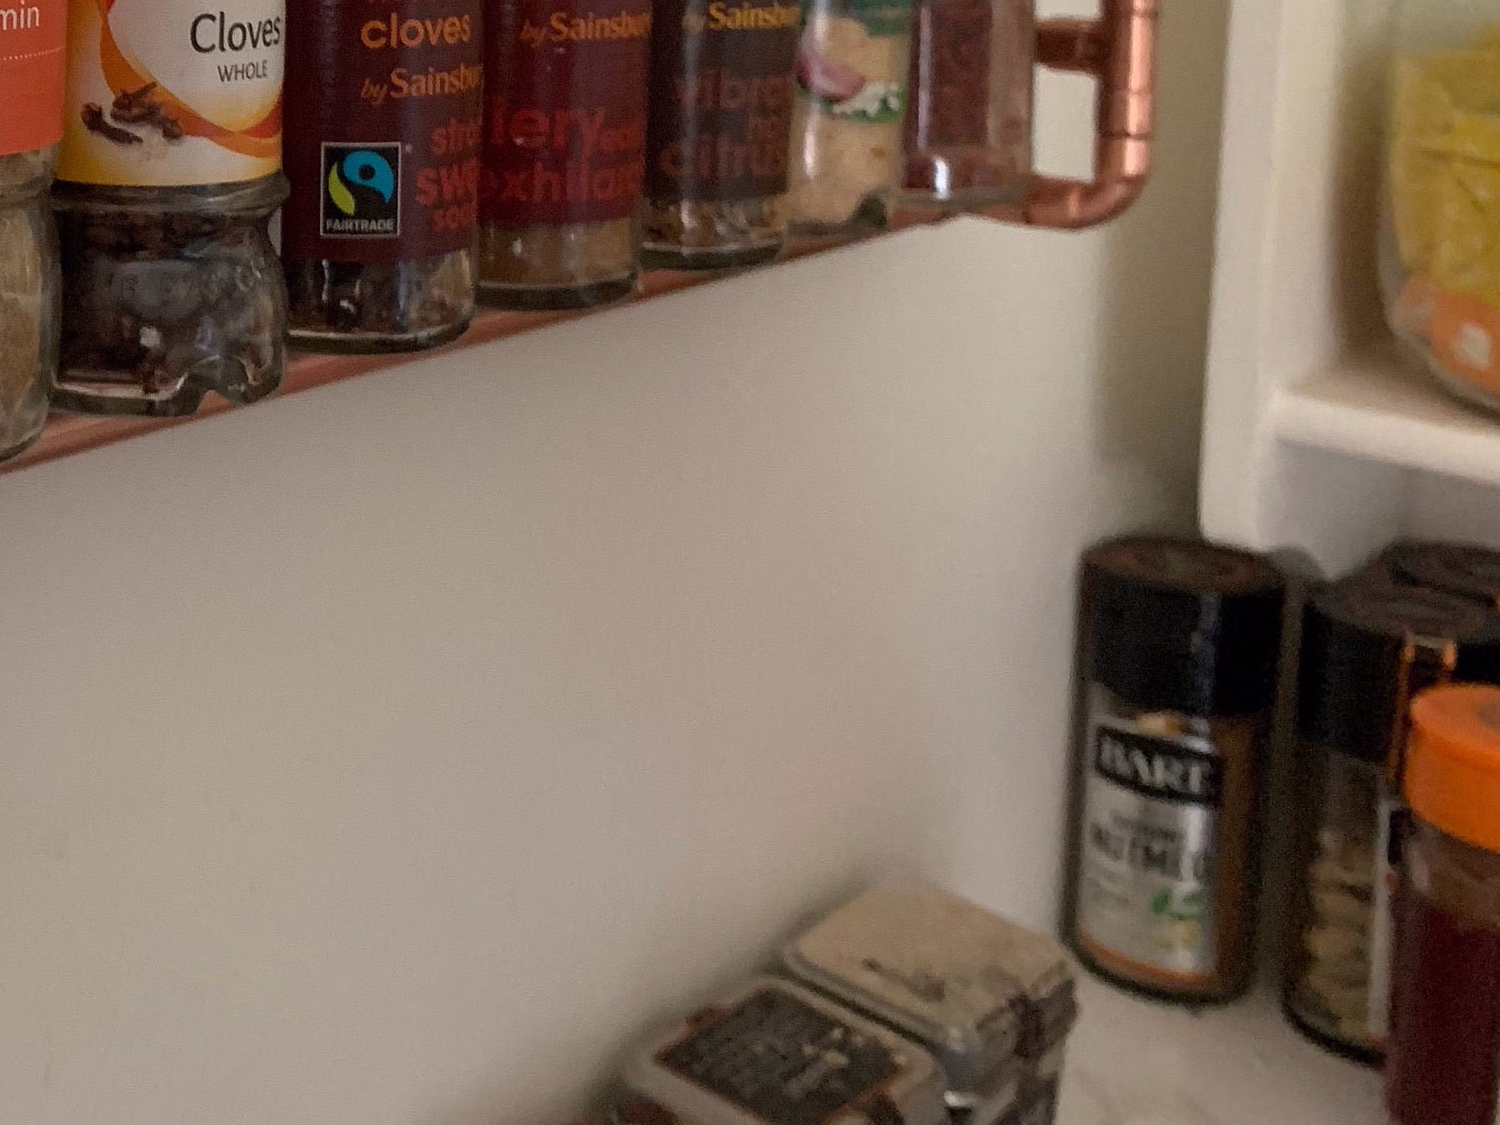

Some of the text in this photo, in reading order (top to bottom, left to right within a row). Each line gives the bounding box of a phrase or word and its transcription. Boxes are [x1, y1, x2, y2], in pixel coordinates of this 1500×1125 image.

[190, 11, 281, 54] Cloves
[361, 12, 470, 49] cloves
[217, 59, 267, 83] WHOLE
[361, 78, 387, 106] by
[326, 218, 394, 233] FAIRTRADE
